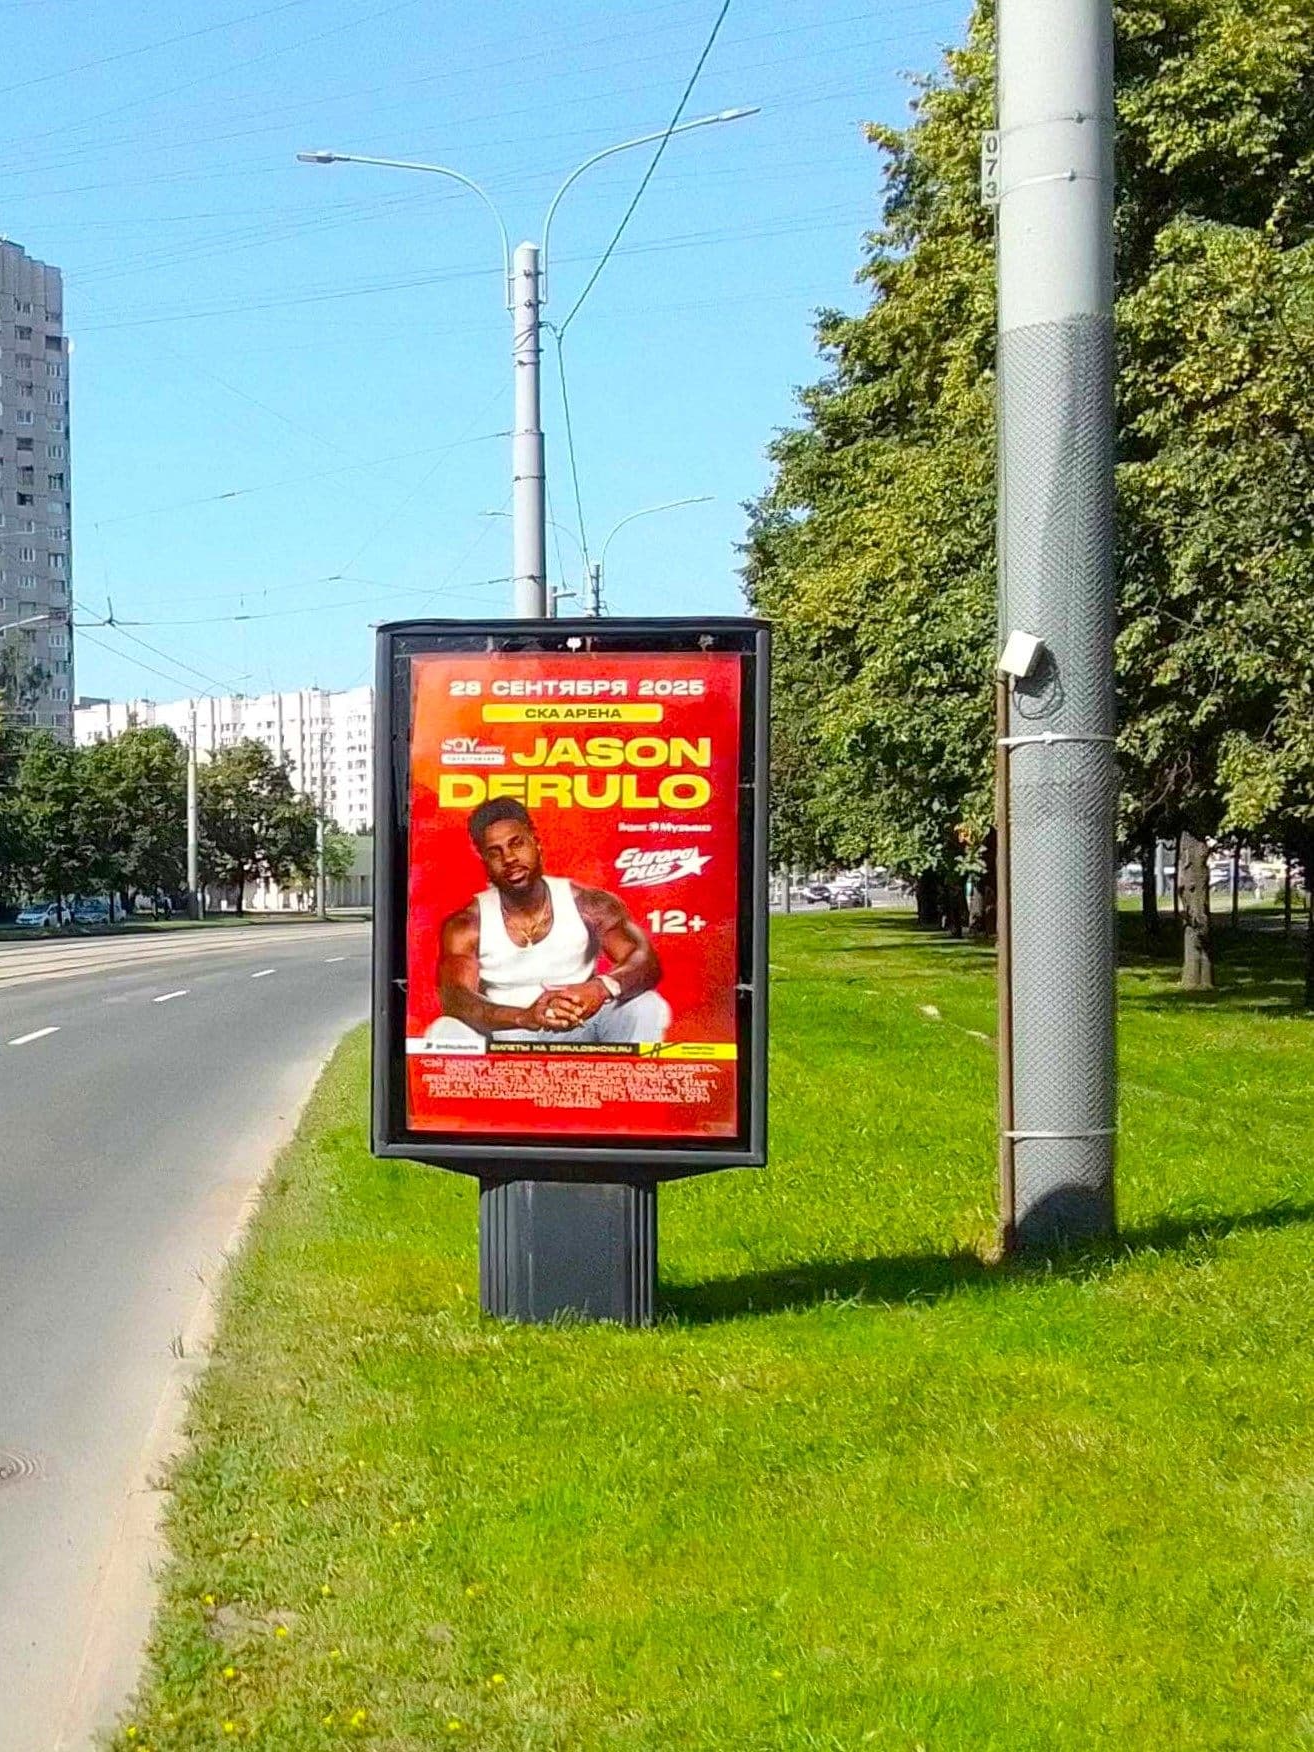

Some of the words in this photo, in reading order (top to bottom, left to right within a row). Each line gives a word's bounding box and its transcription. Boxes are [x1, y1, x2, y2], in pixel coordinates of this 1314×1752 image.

[986, 135, 998, 199] 073
[449, 680, 481, 696] 28
[492, 680, 628, 696] СЕНТЯБРЯ
[638, 680, 705, 696] 2025
[524, 708, 559, 719] СКА
[564, 708, 622, 719] АРЕНА
[512, 737, 711, 767] JASON
[438, 774, 711, 809] DERULO
[647, 909, 706, 933] 12+
